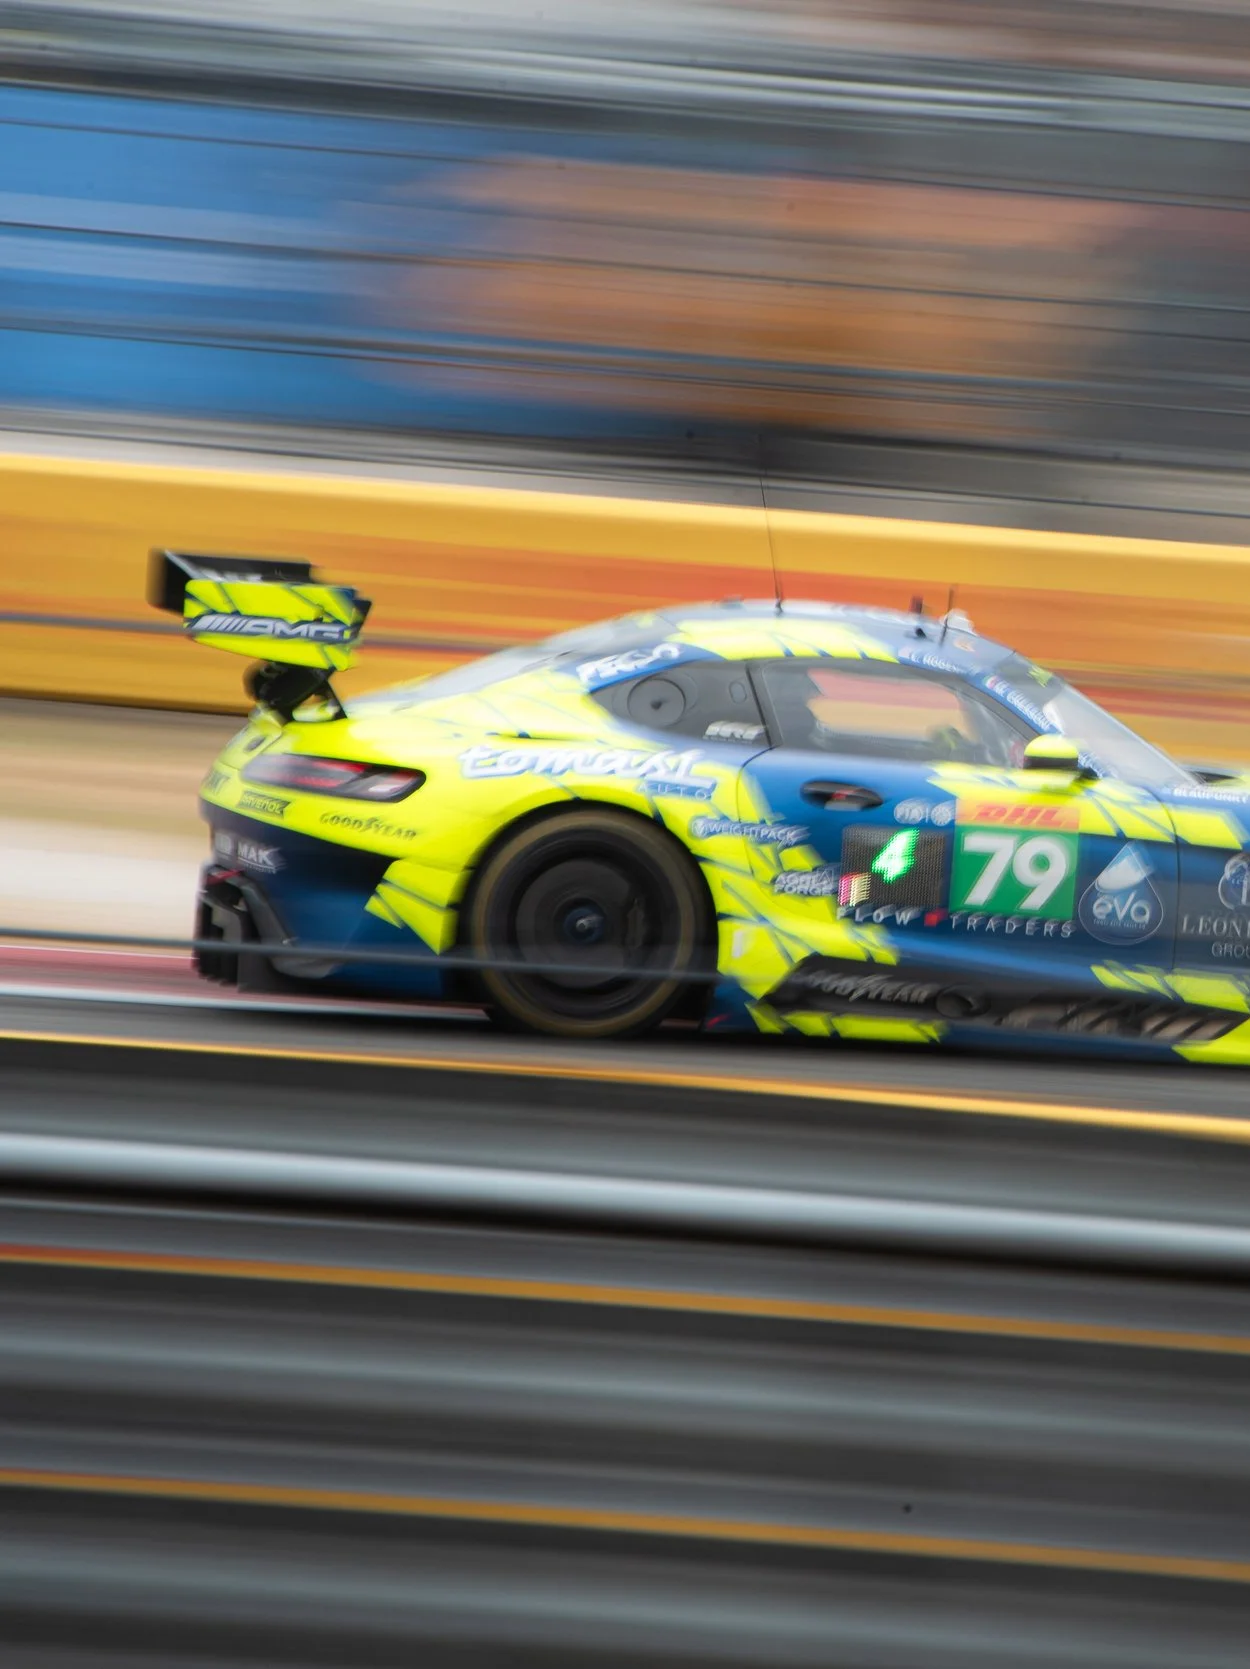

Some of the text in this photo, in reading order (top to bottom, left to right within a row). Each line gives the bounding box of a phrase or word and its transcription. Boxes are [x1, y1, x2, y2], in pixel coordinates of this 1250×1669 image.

[242, 617, 344, 641] AMG
[637, 782, 710, 801] AUTO
[319, 810, 417, 841] GOODYEAR
[974, 803, 1062, 827] DHL
[237, 841, 279, 867] MAK
[871, 828, 920, 884] 4
[961, 832, 1067, 912] 79
[836, 904, 920, 926] FLOW
[950, 911, 1076, 939] TRADERS
